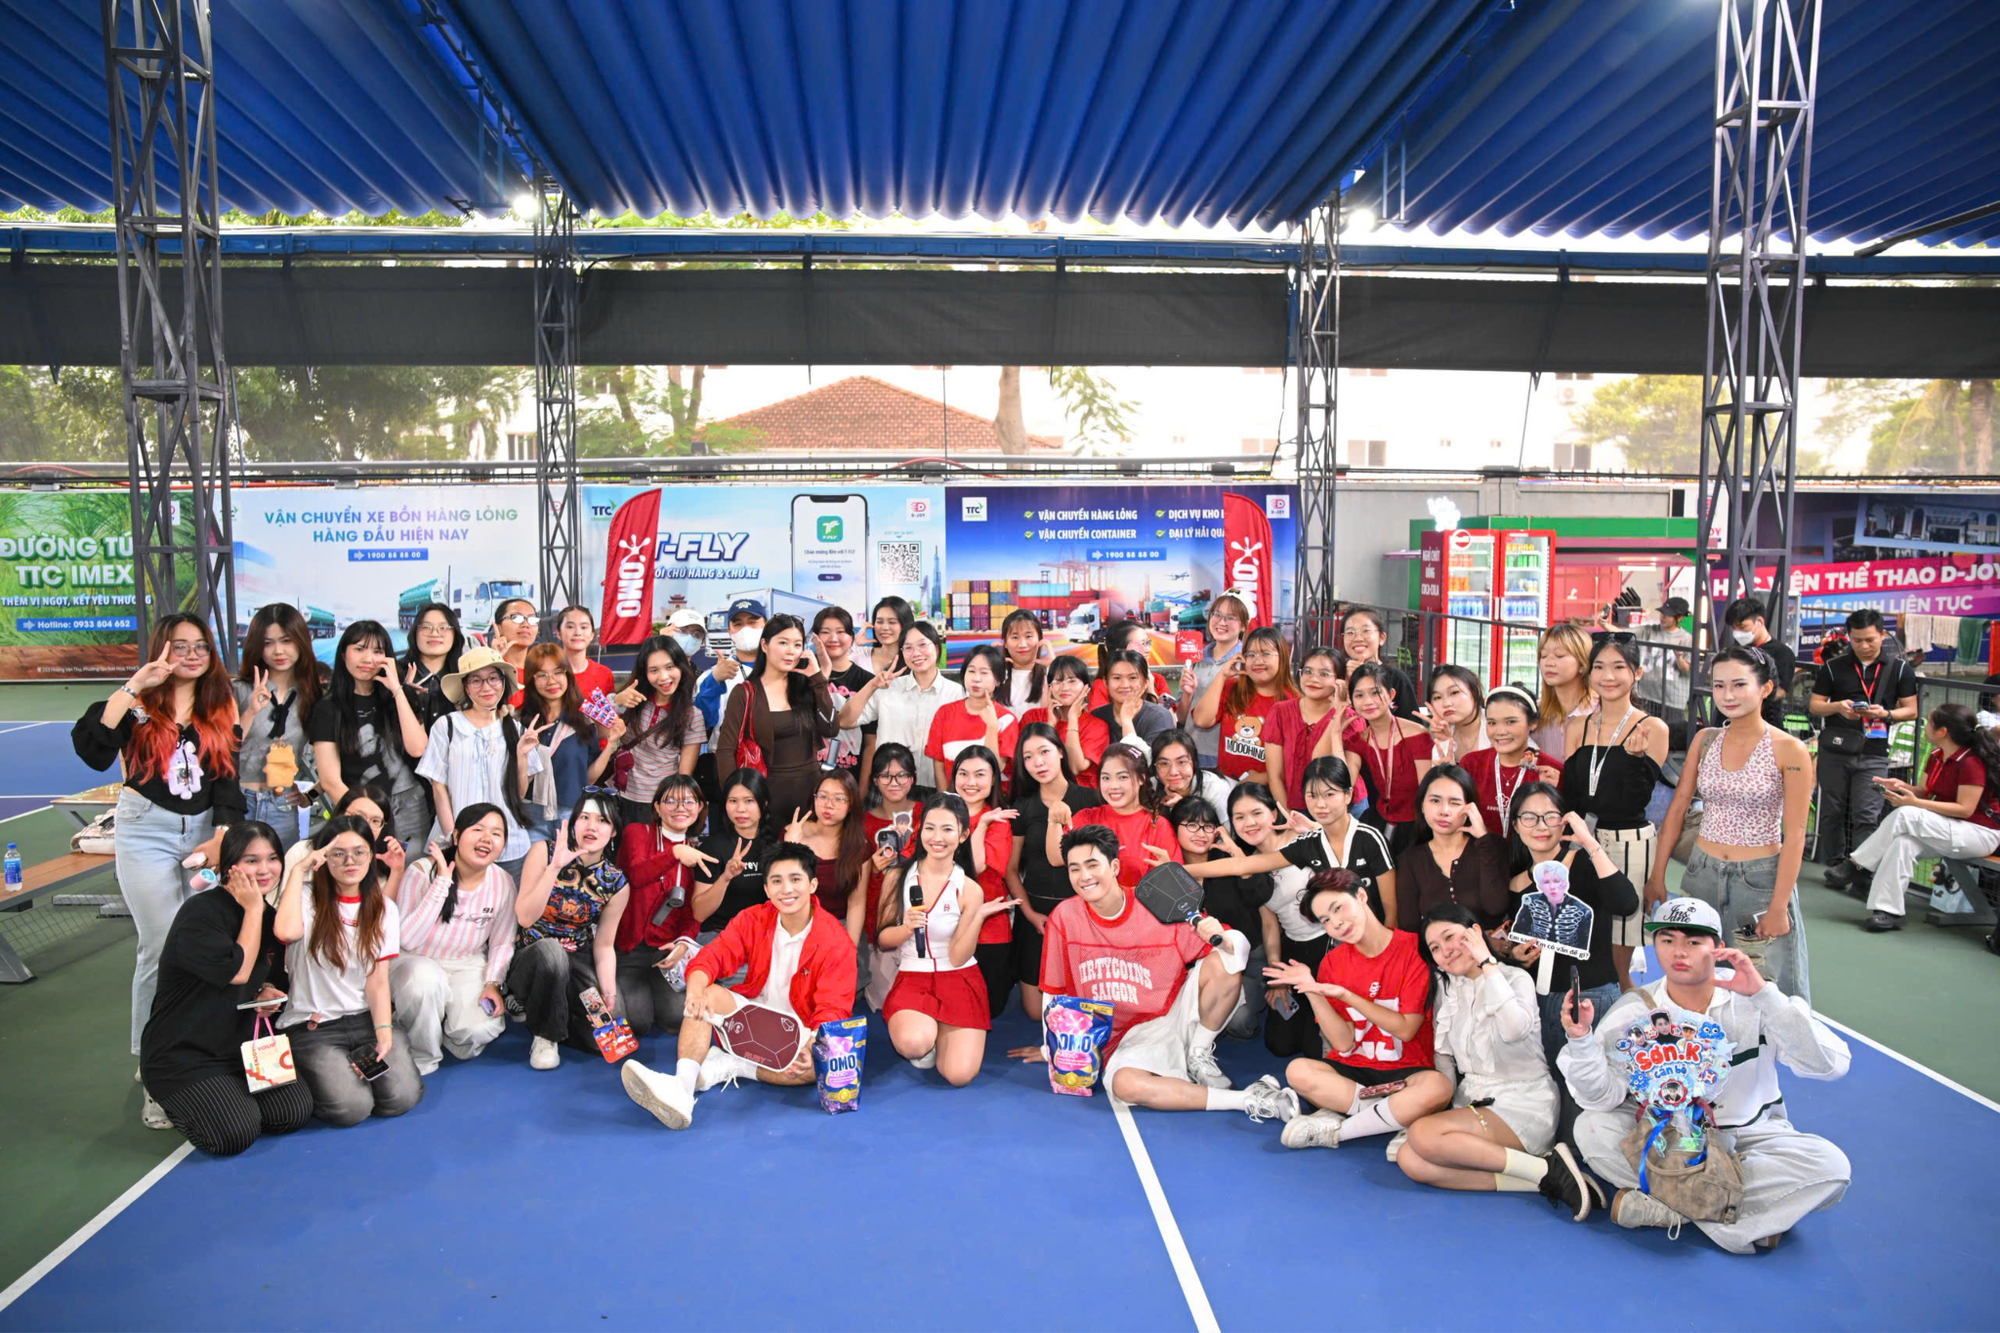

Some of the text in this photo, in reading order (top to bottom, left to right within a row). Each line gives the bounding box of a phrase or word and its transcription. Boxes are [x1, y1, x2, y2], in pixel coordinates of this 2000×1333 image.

[265, 509, 297, 527] VẬN
[301, 505, 361, 524] CHUYỂN
[367, 511, 385, 523] XE
[426, 507, 471, 522] HÀNG
[476, 505, 518, 521] LỎNG
[591, 506, 613, 516] TTC
[965, 506, 981, 514] TTC
[1038, 507, 1138, 523] VẬN CHUYỂN HÀNG LỎNG
[1168, 509, 1188, 522] DỊCH
[1189, 509, 1201, 521] VỤ
[1202, 508, 1220, 519] KHO
[313, 527, 358, 542] HÀNG
[400, 526, 434, 544] HIỆN
[439, 529, 469, 540] NAY
[1038, 526, 1137, 542] VẬN CHUYỂN CONTAINER
[1169, 529, 1184, 541] ĐẠI
[1185, 527, 1194, 538] LÝ
[1195, 526, 1210, 538] HẢI
[0, 533, 98, 558] ĐƯỜNG
[15, 564, 134, 586] TTC IMEX
[688, 568, 716, 579] HÀNG
[716, 569, 725, 579] &
[746, 568, 759, 579] XE
[1825, 561, 1870, 590] THỂ
[1874, 567, 1936, 586] THAO
[616, 560, 646, 618] OMO
[2, 595, 28, 606] THÊM
[30, 597, 41, 608] VỊ
[43, 597, 71, 608] NGỌT,
[73, 593, 92, 605] KẾT
[92, 595, 110, 605] YÊU
[1890, 594, 1931, 614] LIÊN
[1935, 595, 1974, 615] TỤC
[37, 621, 71, 629] Hotline:
[114, 620, 131, 628] 652
[1091, 982, 1139, 1005] SAIGON
[744, 1051, 767, 1063] RUBY
[829, 1054, 857, 1072] OMO
[1674, 1063, 1688, 1075] bộ
